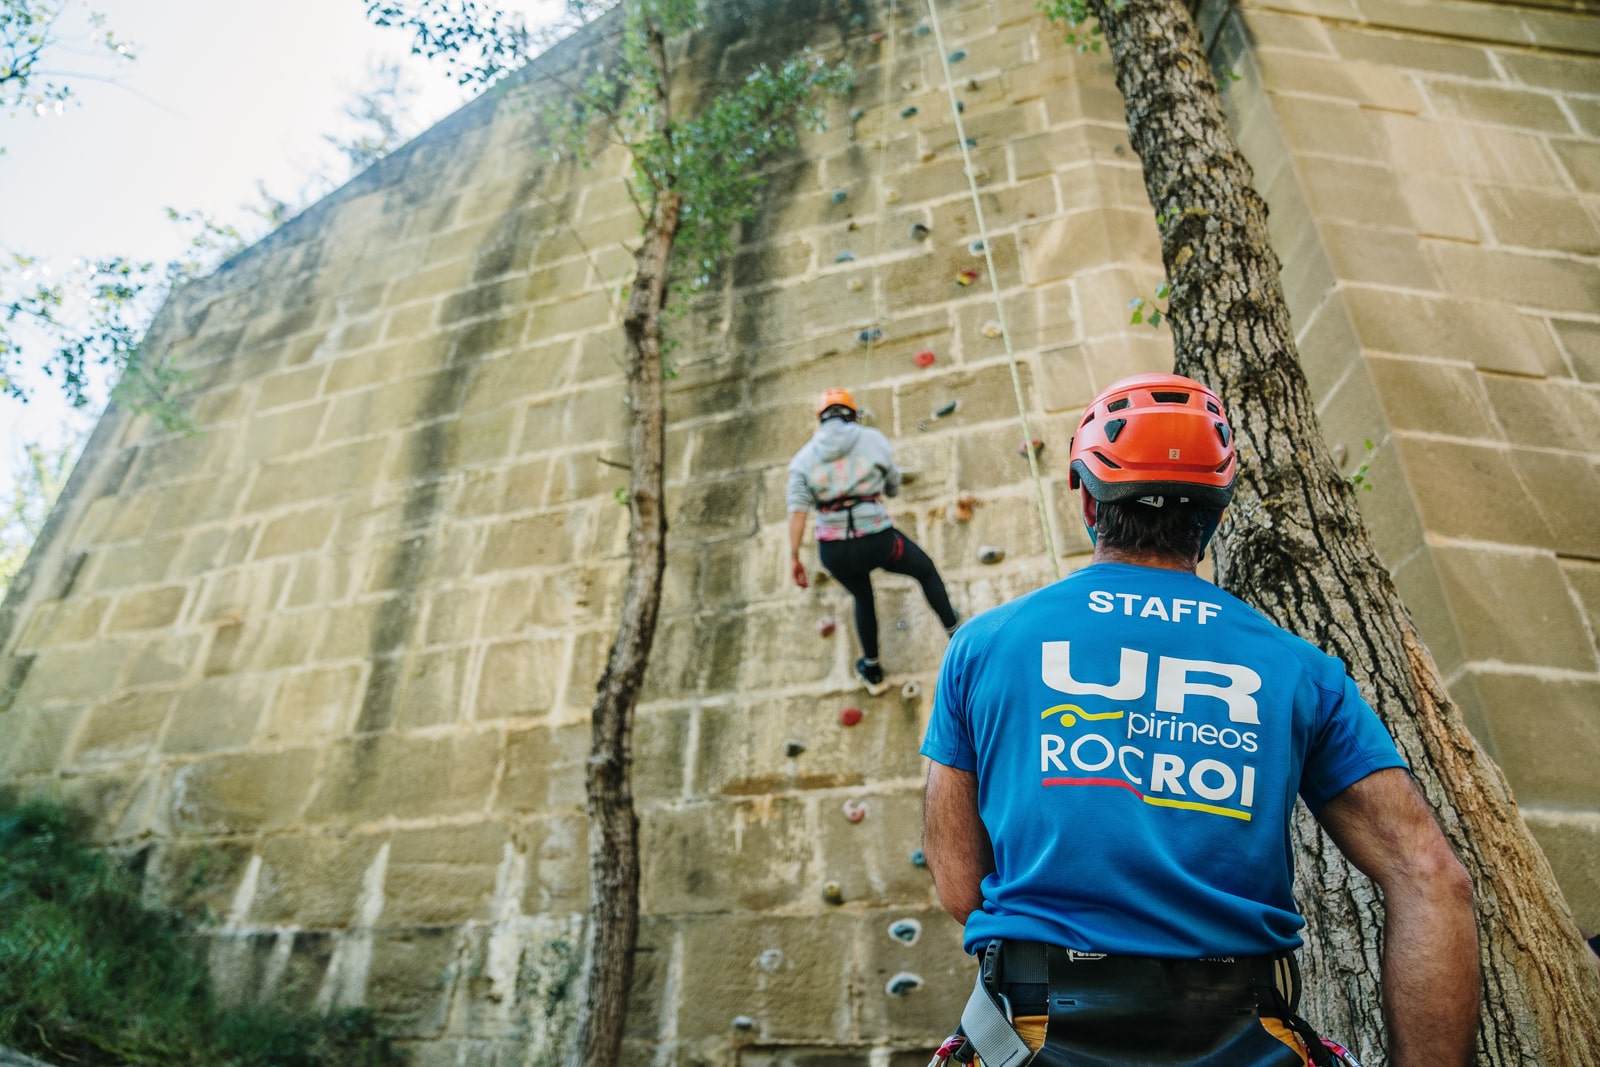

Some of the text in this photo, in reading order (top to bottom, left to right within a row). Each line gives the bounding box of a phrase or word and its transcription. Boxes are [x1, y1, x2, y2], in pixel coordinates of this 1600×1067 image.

[1088, 590, 1222, 625] STAFF
[1041, 640, 1262, 725] UR
[1127, 711, 1258, 753] pirineos
